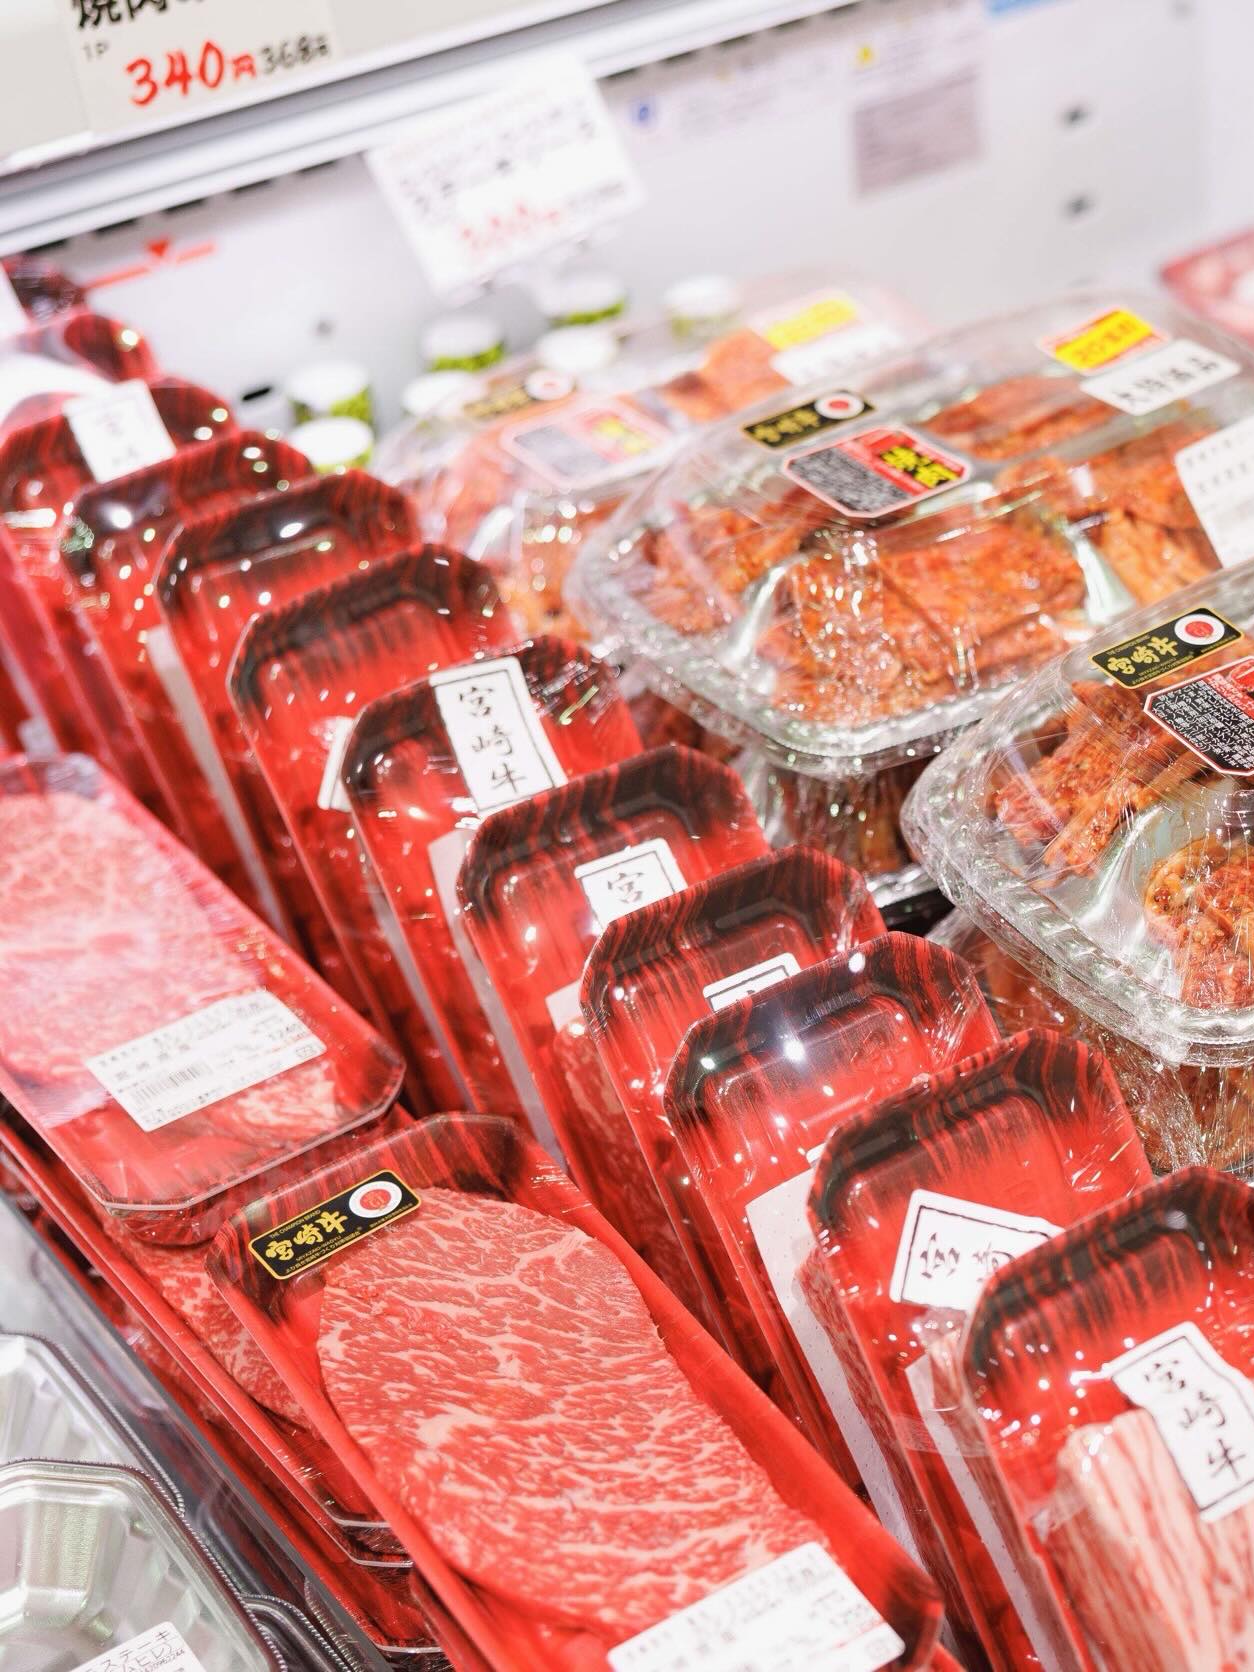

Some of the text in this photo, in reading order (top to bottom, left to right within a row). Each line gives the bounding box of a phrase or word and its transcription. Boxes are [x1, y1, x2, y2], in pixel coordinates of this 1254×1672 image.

[1107, 635, 1179, 676] 宮崎牛
[457, 685, 528, 794] 宮崎牛
[607, 872, 645, 905] 宮
[265, 1210, 349, 1262] 宮崎牛
[1143, 1359, 1247, 1481] 宮崎牛
